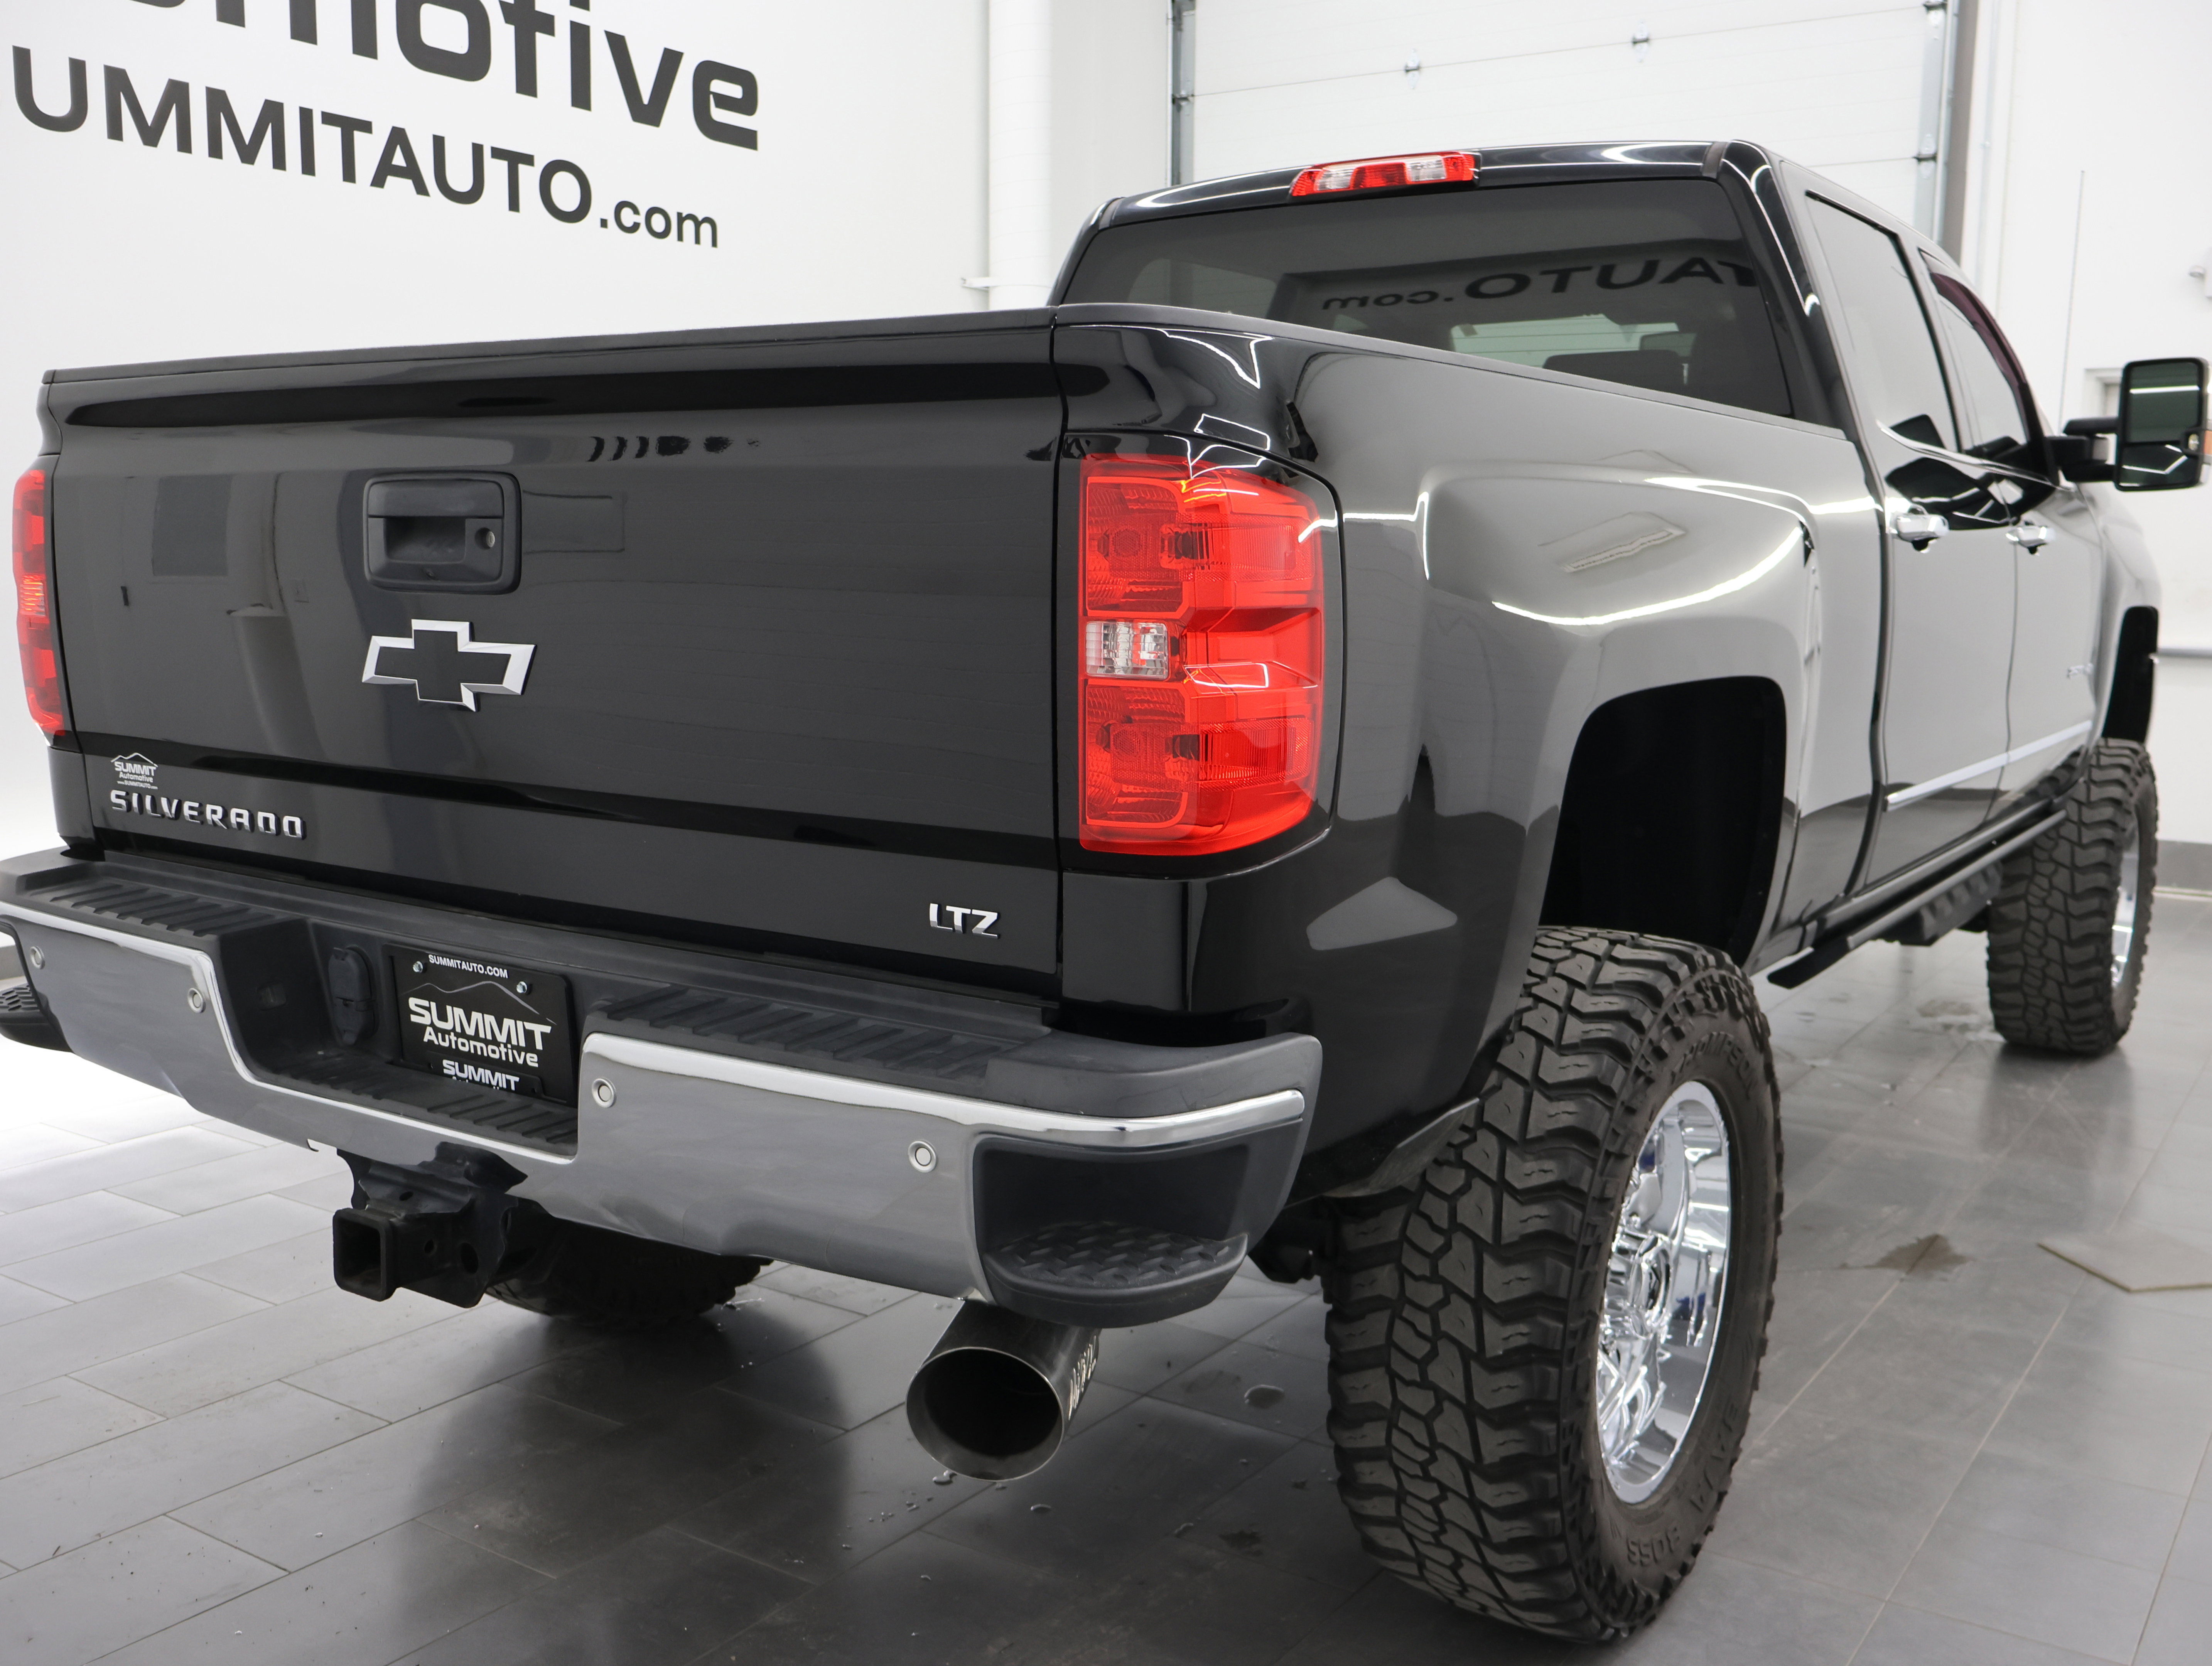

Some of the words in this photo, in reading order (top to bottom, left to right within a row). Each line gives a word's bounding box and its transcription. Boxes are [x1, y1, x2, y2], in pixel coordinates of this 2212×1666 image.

[131, 0, 759, 151] otive
[12, 46, 719, 249] UMMITAUTO.com
[115, 761, 157, 776] SUMMIT
[119, 772, 153, 783] Automotive
[110, 789, 306, 840] SILVERADO
[930, 903, 998, 939] LTZ
[428, 954, 508, 979] SUMMITAUTO.COM
[408, 997, 552, 1051] SUMMIT
[423, 1026, 538, 1067] Automotive
[442, 1059, 520, 1091] SUMMIT
